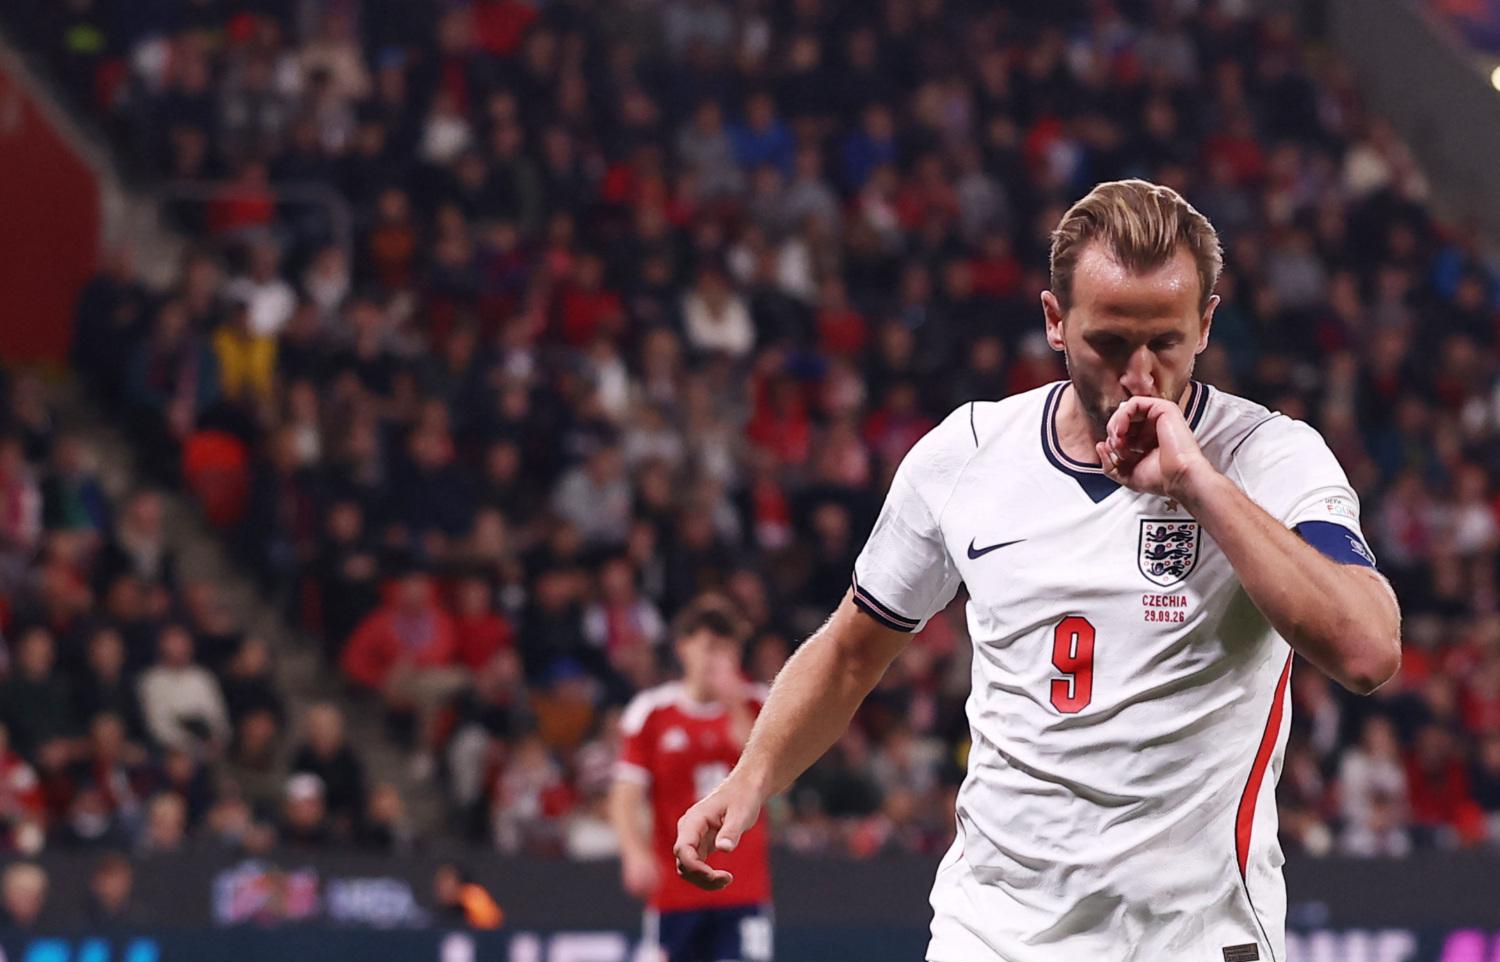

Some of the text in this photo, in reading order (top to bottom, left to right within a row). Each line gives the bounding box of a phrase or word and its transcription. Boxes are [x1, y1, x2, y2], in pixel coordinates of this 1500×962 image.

[1142, 594, 1187, 607] CZECHIA
[1144, 610, 1185, 623] 29.09.26
[1050, 616, 1095, 714] 9
